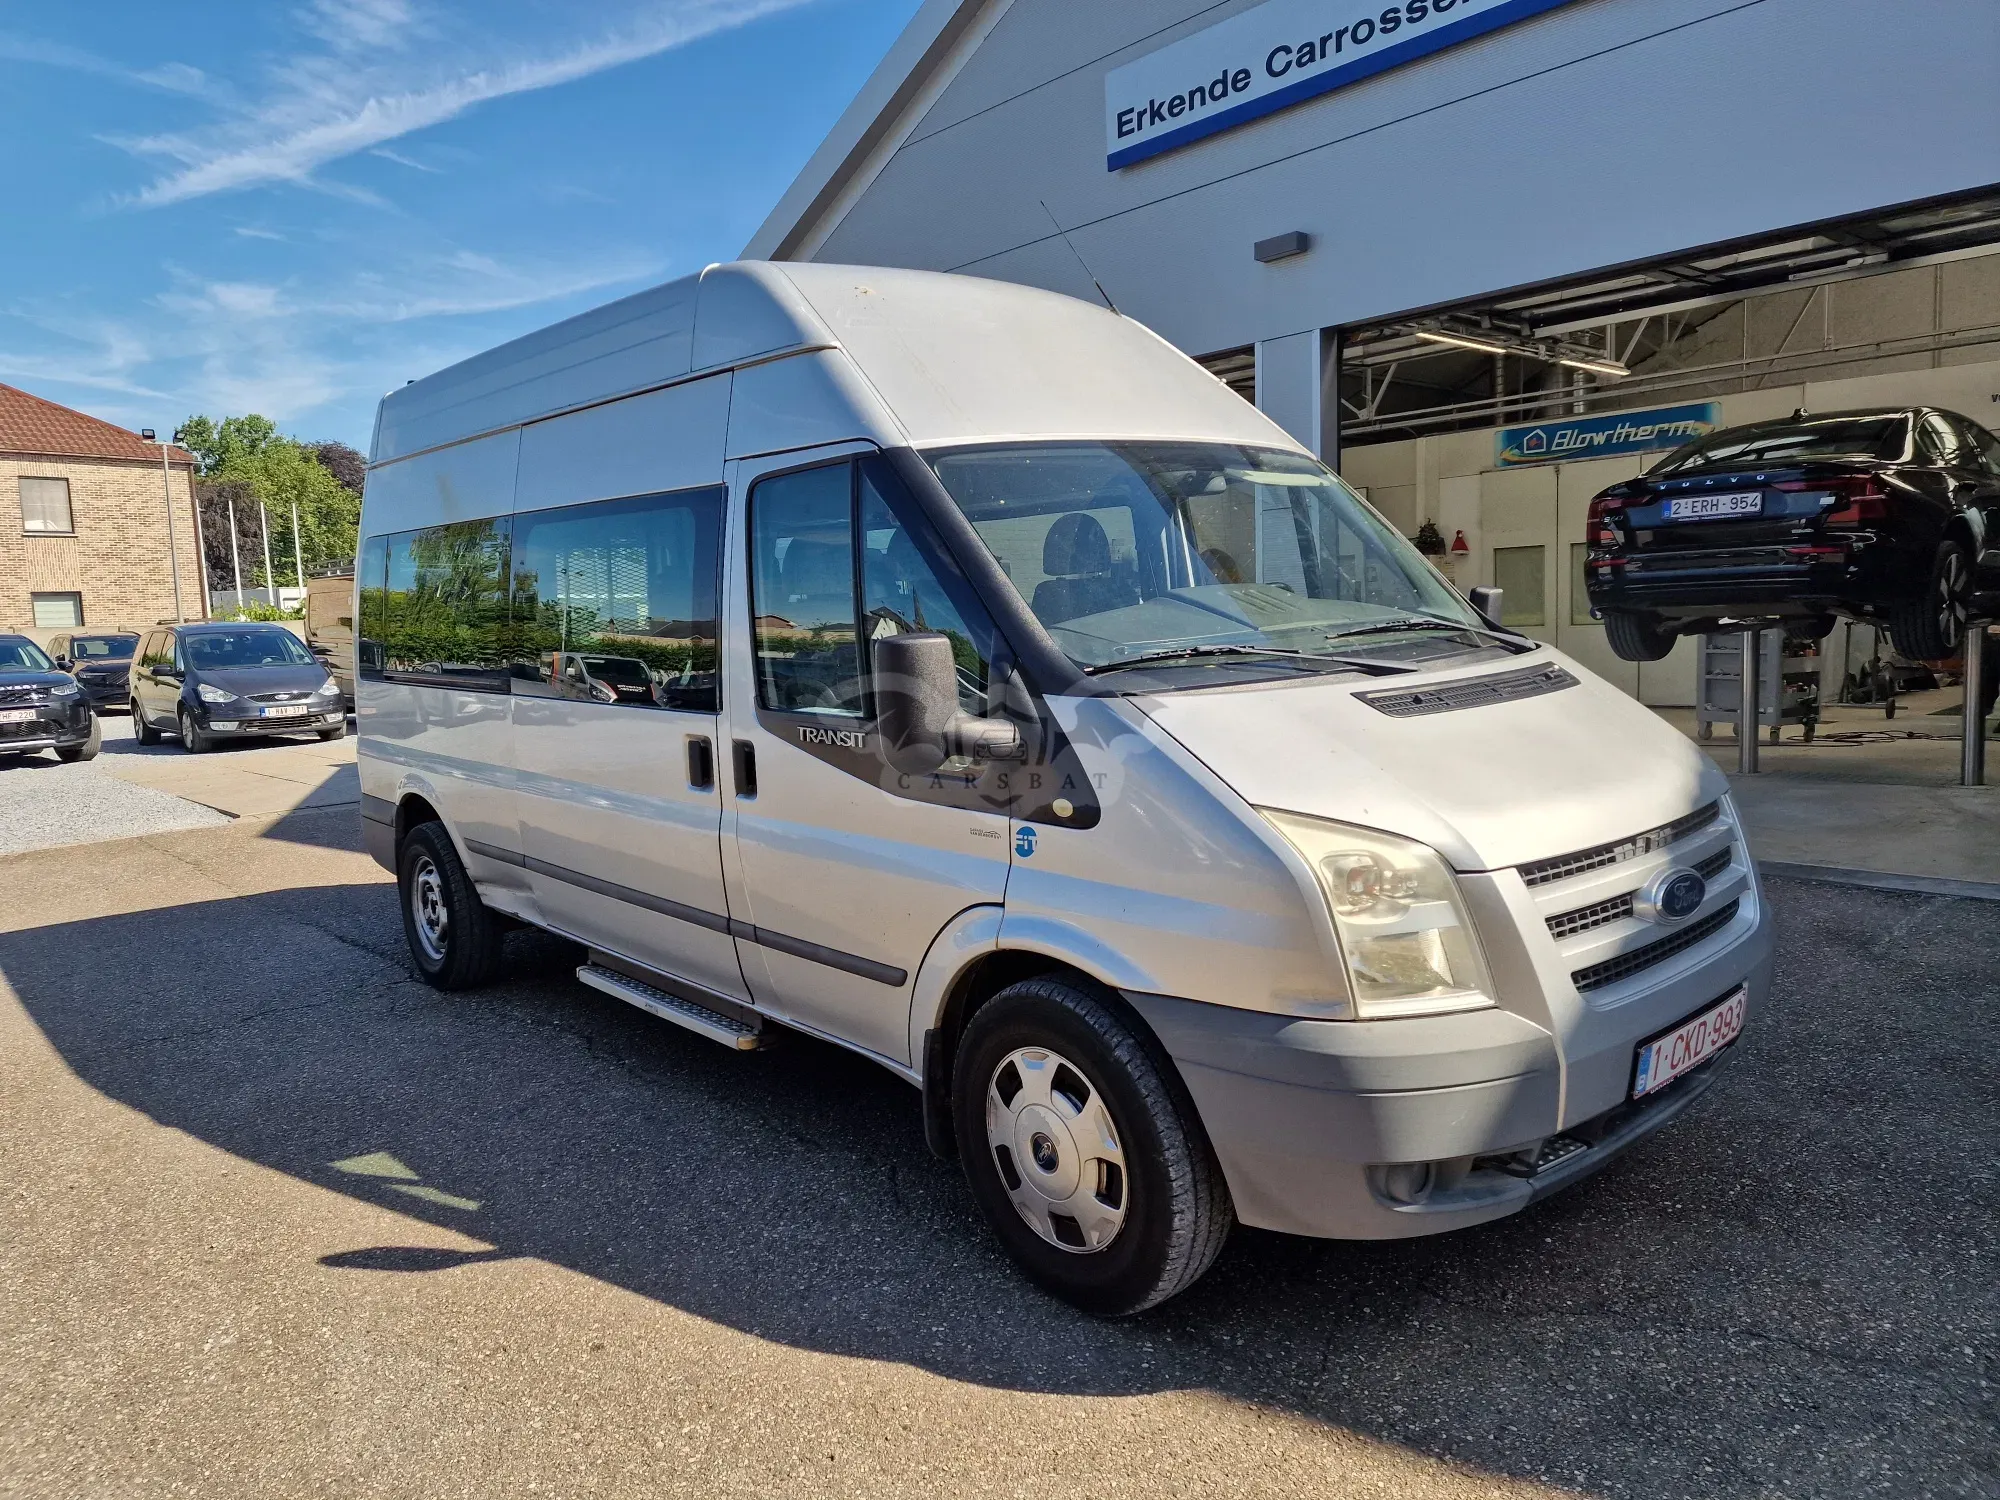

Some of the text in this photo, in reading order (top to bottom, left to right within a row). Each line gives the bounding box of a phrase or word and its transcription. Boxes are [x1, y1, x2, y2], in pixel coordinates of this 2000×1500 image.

[1116, 0, 1470, 139] Erkende Carross
[1551, 419, 1696, 451] Blowtherm
[1660, 474, 1765, 490] VOLVO
[797, 726, 866, 748] TRANSIT
[1653, 998, 1743, 1083] 1-CKD-993
